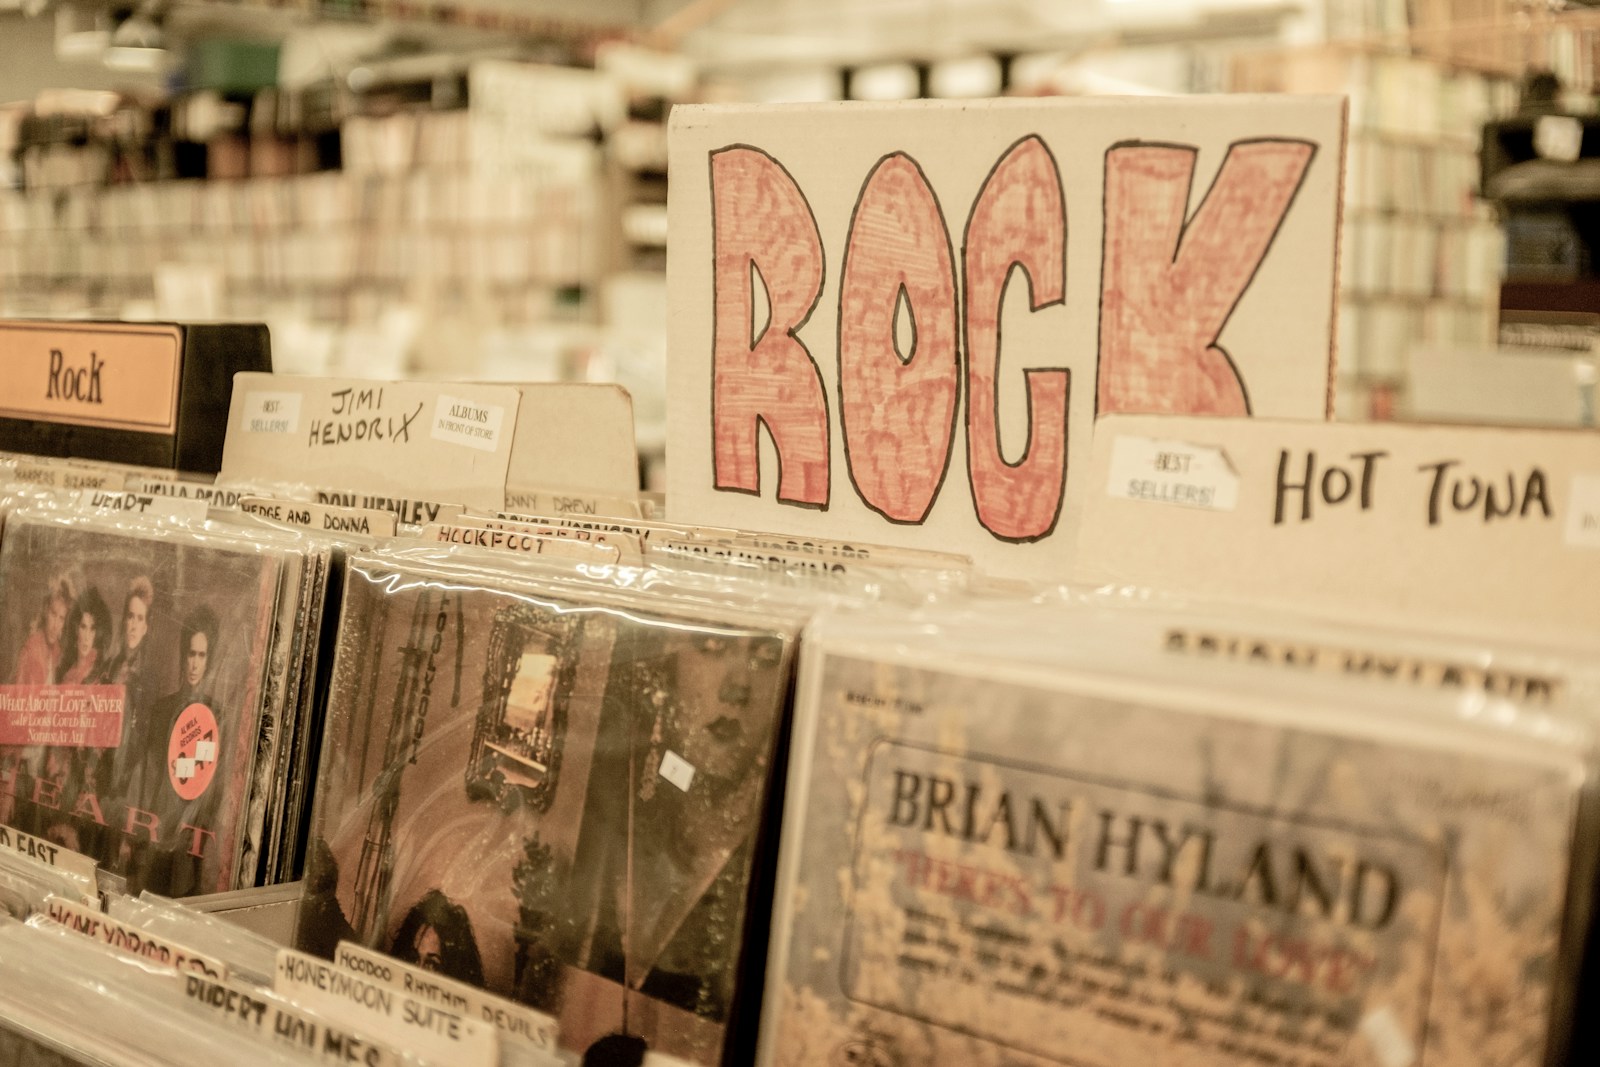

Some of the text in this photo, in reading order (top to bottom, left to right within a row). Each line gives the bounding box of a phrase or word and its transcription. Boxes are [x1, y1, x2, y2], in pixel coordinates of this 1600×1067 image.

[708, 134, 1320, 544] ROCK
[46, 349, 105, 404] Rock
[331, 387, 384, 416] JIMI
[449, 404, 489, 423] ALBUMS
[250, 419, 289, 433] SELLERS!
[308, 402, 423, 448] HENDRIX
[438, 418, 494, 440] IN FRONT OF STORE
[505, 493, 597, 514] ENNY DREW
[1127, 478, 1216, 508] SELLERS!
[1273, 449, 1554, 527] HOT TUNA
[286, 510, 311, 525] AND
[323, 513, 370, 534] DONNA
[408, 592, 450, 765] HOOKFOOT
[26, 693, 58, 712] ABOUT
[59, 694, 88, 713] LOVE
[89, 695, 122, 713] NEVER
[179, 726, 202, 748] RECORDS
[16, 833, 59, 866] EAST
[888, 769, 1400, 931] BRIAN HYLAND
[285, 955, 460, 1041] HONEYMOON SUITE
[339, 951, 547, 1046] HOODOO RHYTHM DEVILS
